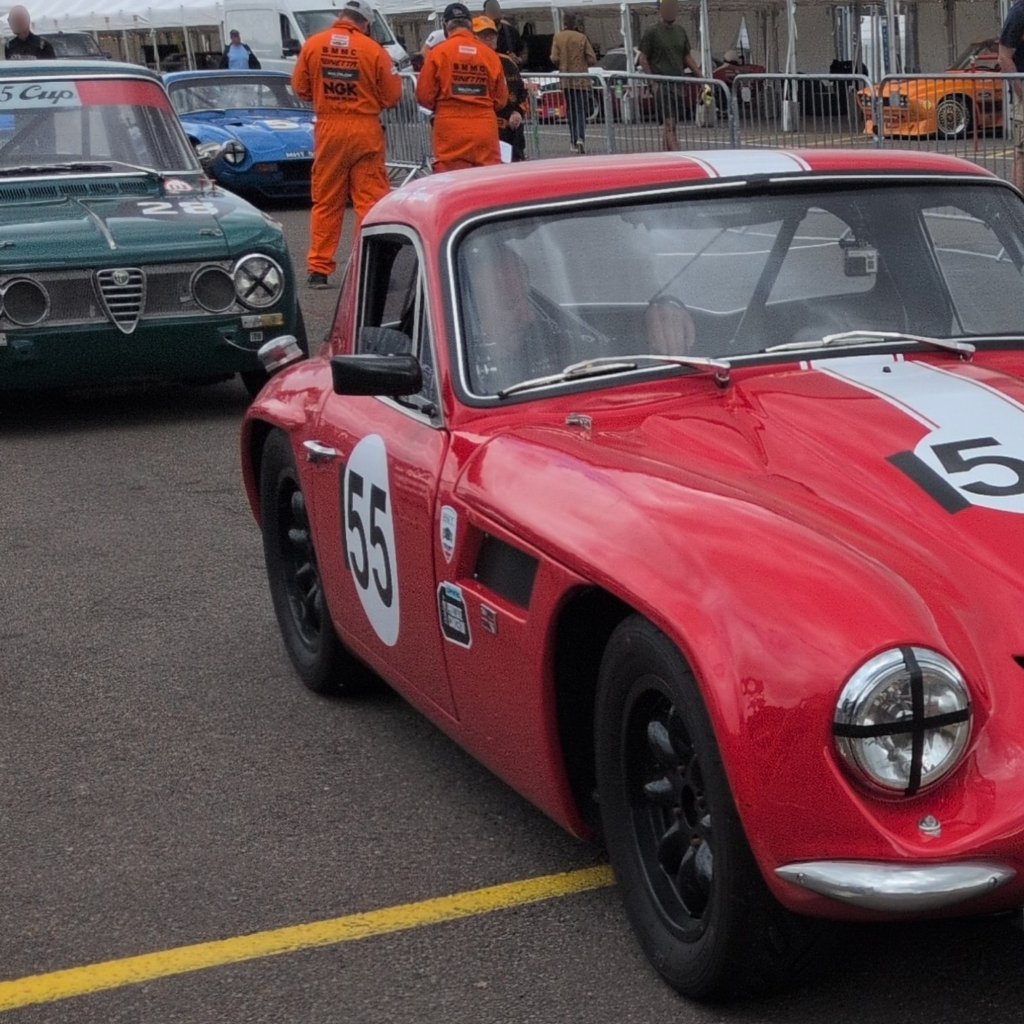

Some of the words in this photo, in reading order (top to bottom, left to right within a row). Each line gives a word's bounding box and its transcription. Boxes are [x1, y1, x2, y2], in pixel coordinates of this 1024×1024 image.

[19, 84, 74, 105] Cup
[323, 81, 358, 97] NGK
[137, 201, 219, 215] 28
[348, 469, 393, 608] 55
